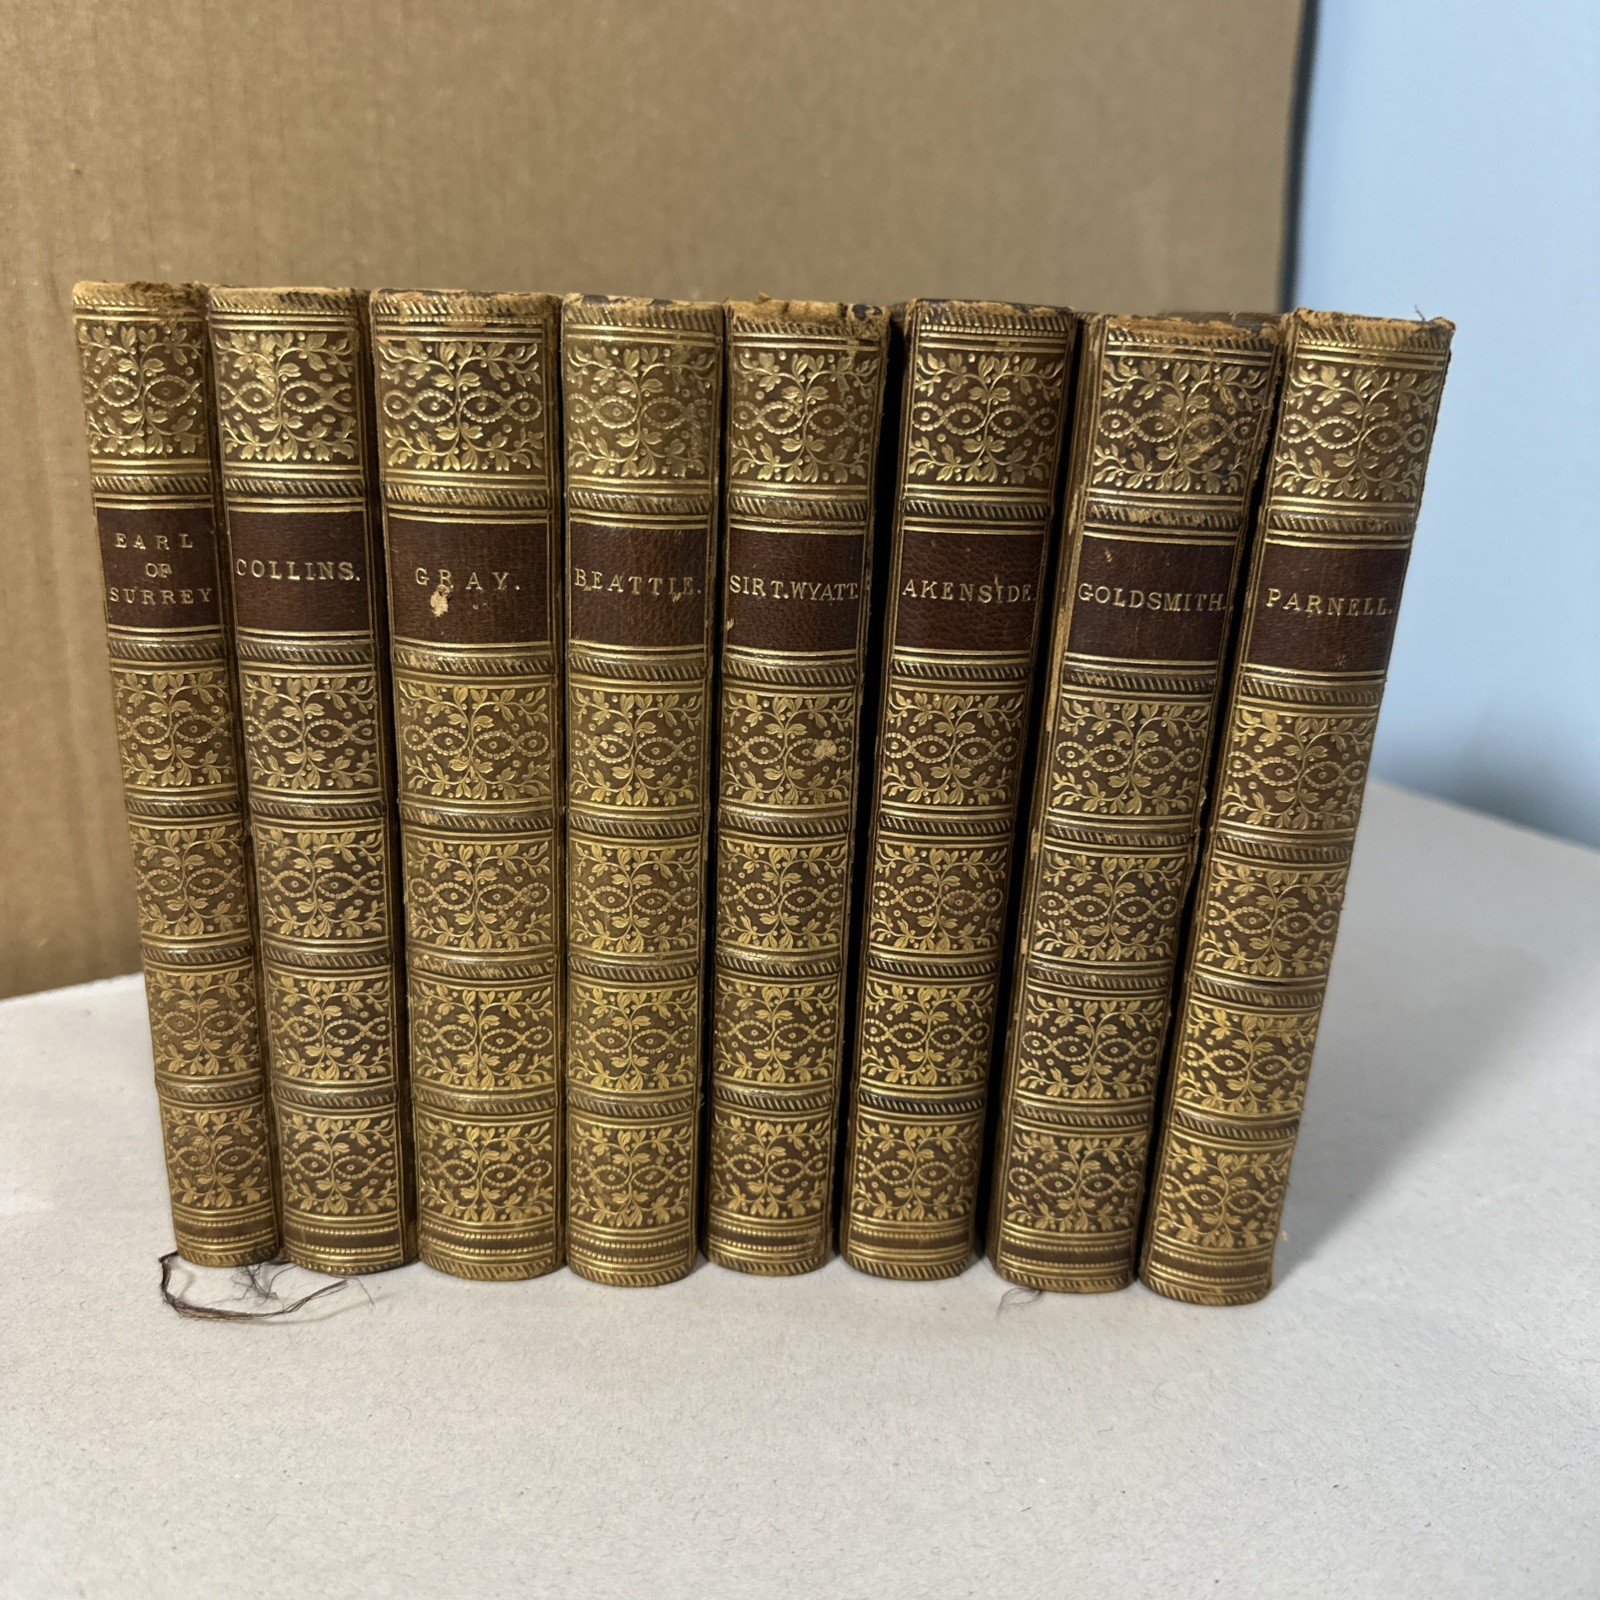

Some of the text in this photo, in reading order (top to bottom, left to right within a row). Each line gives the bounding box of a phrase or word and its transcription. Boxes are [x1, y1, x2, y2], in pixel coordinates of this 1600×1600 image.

[114, 532, 193, 550] EARL
[145, 563, 173, 578] OF
[235, 558, 360, 581] COLLINS.
[574, 567, 702, 595] BEATTIE.
[109, 587, 212, 606] SURREY
[729, 574, 766, 597] SIR
[1266, 587, 1394, 616] PARNELL.
